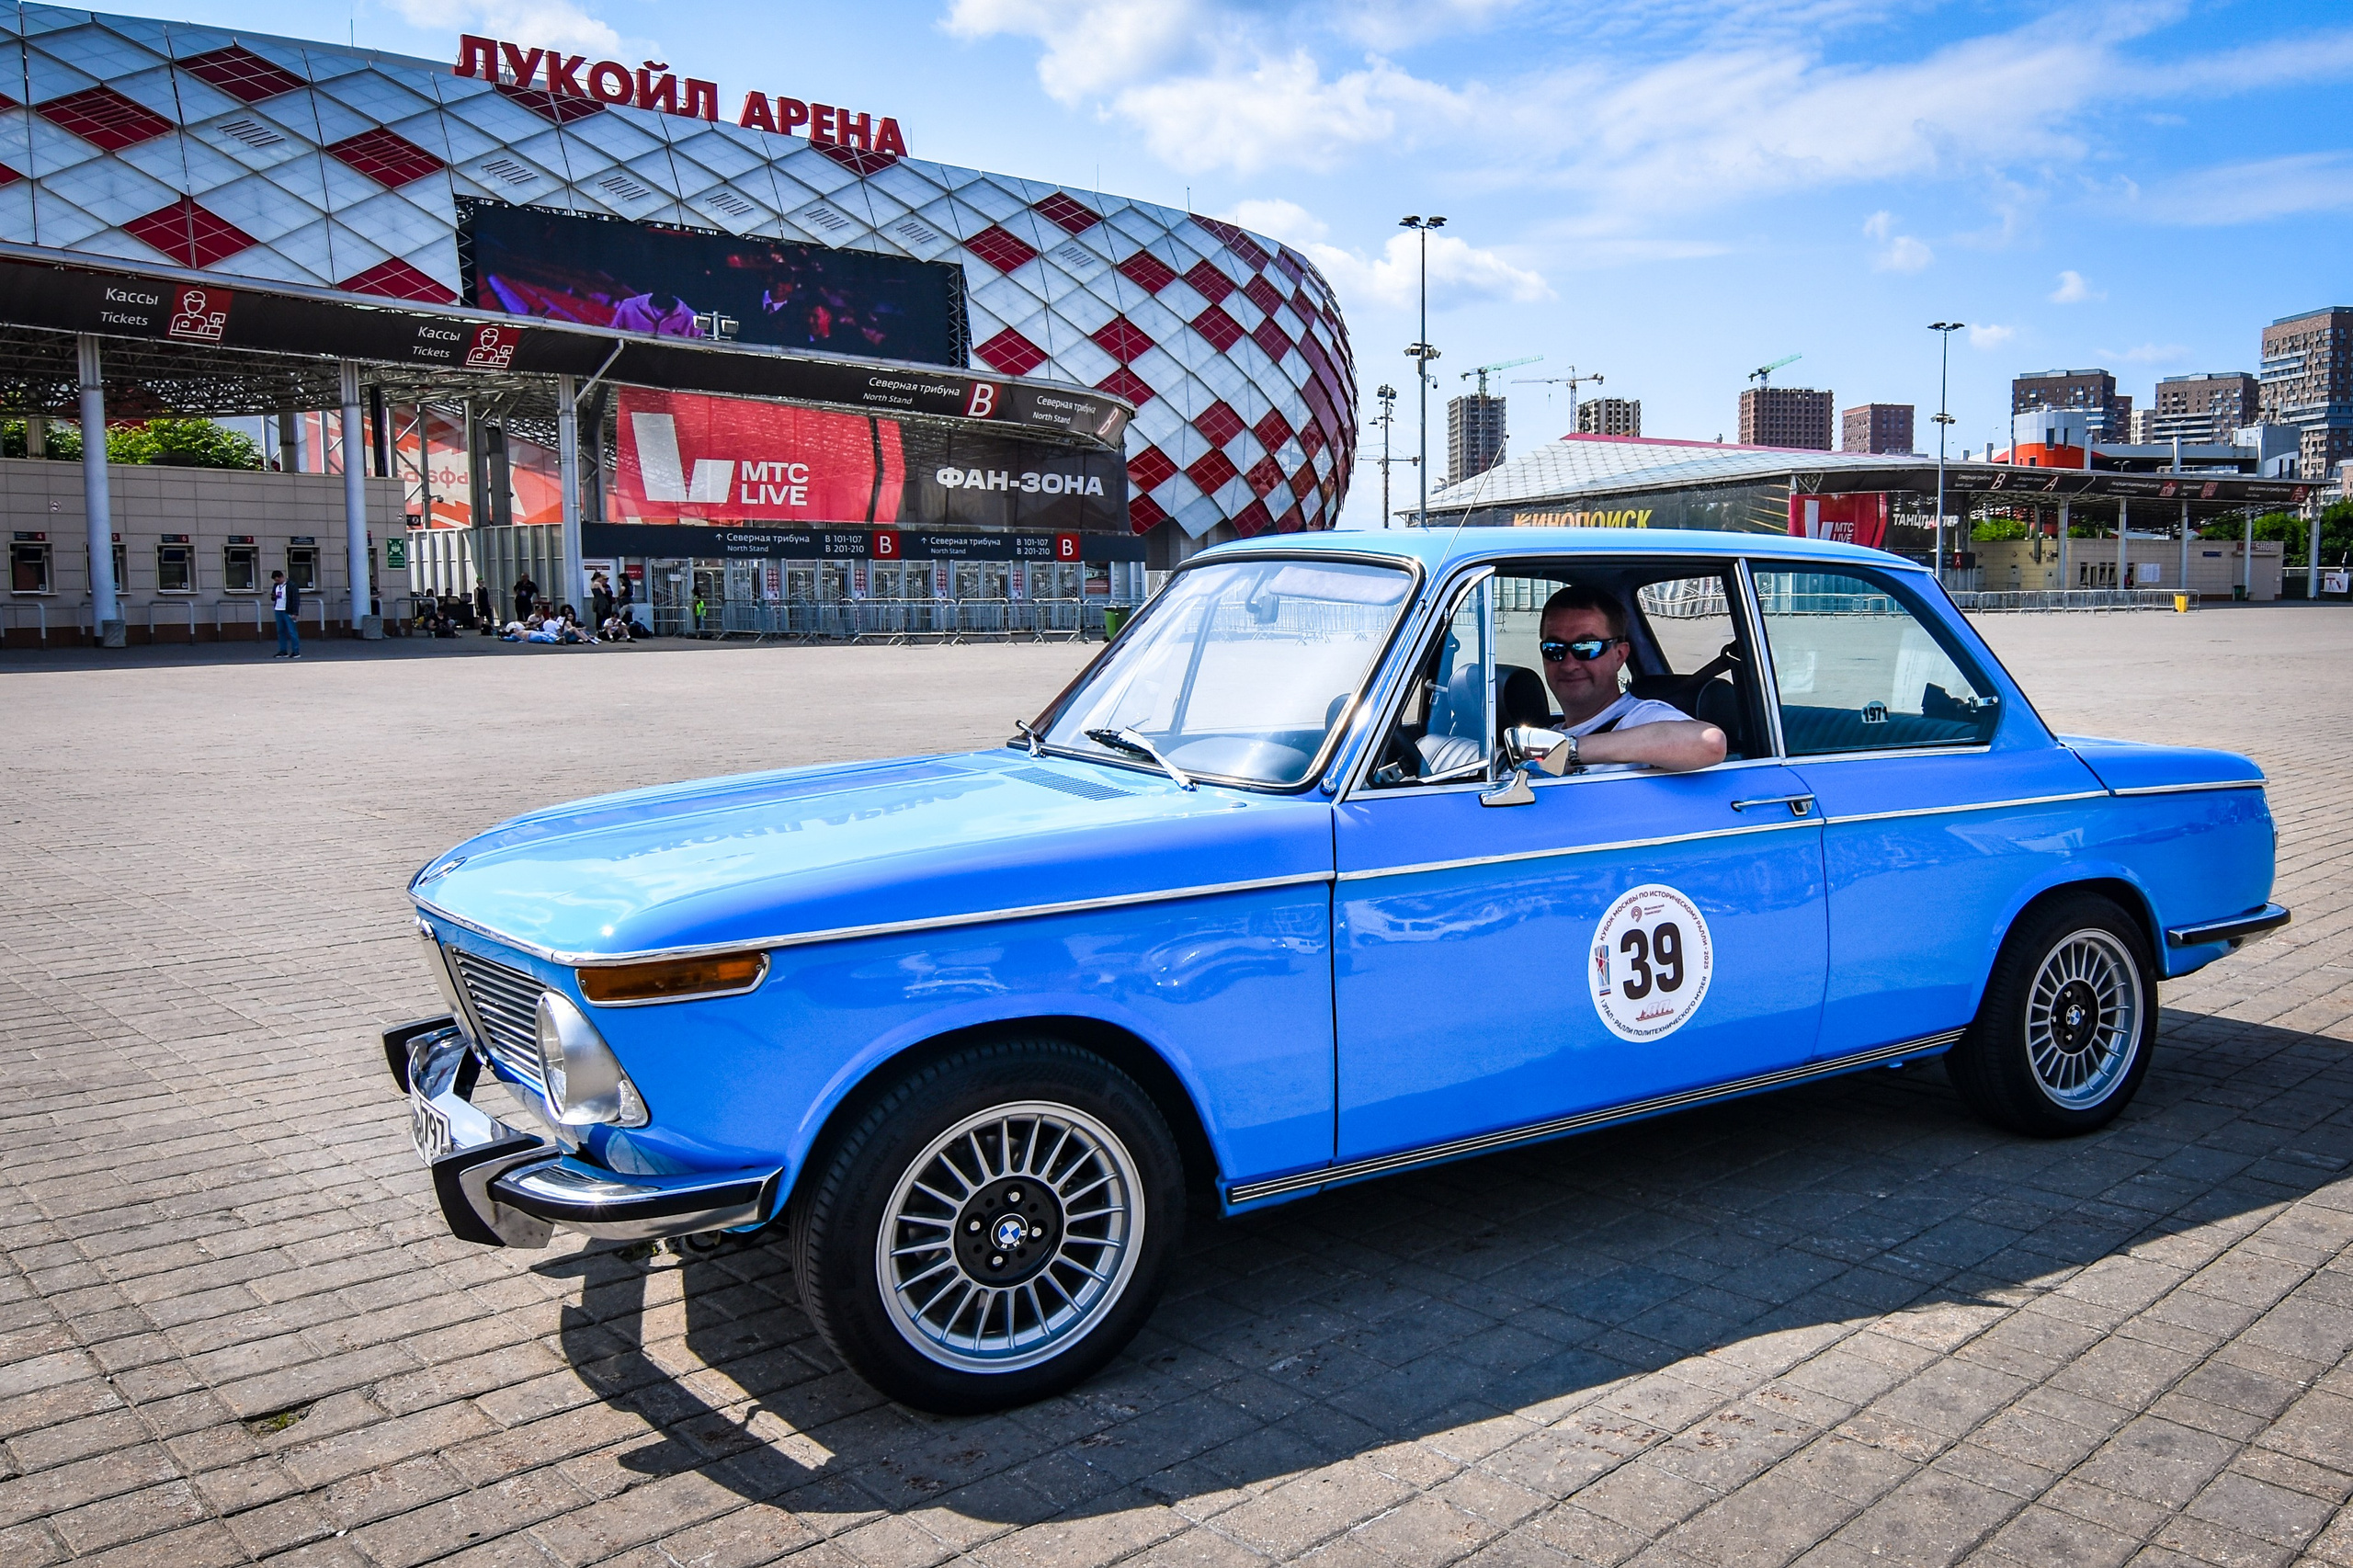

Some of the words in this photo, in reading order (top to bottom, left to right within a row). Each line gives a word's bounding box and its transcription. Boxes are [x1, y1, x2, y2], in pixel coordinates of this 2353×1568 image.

[451, 33, 719, 122] ЛУКОЙЛ
[738, 90, 908, 156] АРЕНА
[105, 287, 159, 305] Кассы
[100, 311, 149, 326] Tickets
[417, 326, 460, 341] Кассы
[412, 346, 450, 358] Tickets
[869, 377, 917, 392] Северная
[919, 383, 961, 397] трибуна
[862, 392, 888, 403] North
[888, 394, 913, 405] Stand
[1037, 395, 1074, 410] Северная
[1074, 403, 1097, 415] трибуна
[1032, 411, 1053, 422] North
[1053, 415, 1071, 425] Stand
[741, 460, 810, 483] МТС
[936, 467, 1104, 496] ФАН-ЗОНА
[741, 483, 808, 506] LIVE
[1834, 521, 1855, 533] МТС
[1893, 513, 1960, 528] ТАНЦПАТЕР
[726, 532, 771, 544] Северная
[773, 534, 810, 544] трибуна
[834, 535, 862, 543] 101-107
[930, 537, 968, 547] Северная
[969, 538, 1001, 547] трибуна
[1833, 532, 1852, 542] LIVE
[834, 545, 865, 553] 201-210
[1862, 706, 1888, 722] 1971
[1599, 915, 1615, 941] КУБОК
[1612, 894, 1639, 917] МОСКВЫ
[1639, 891, 1649, 899] ПО
[1649, 890, 1699, 920] ИСТОРИЧЕСКОМУ
[1695, 920, 1708, 946] РАЛЛИ
[1620, 922, 1684, 1000] 39
[1601, 1002, 1614, 1019] ЭТАП
[1613, 1018, 1633, 1035] РАЛЛИ
[1632, 1000, 1696, 1036] ПОЛИТЕХНИЧЕСКОГО
[1694, 975, 1707, 1001] МУЗЕЯ
